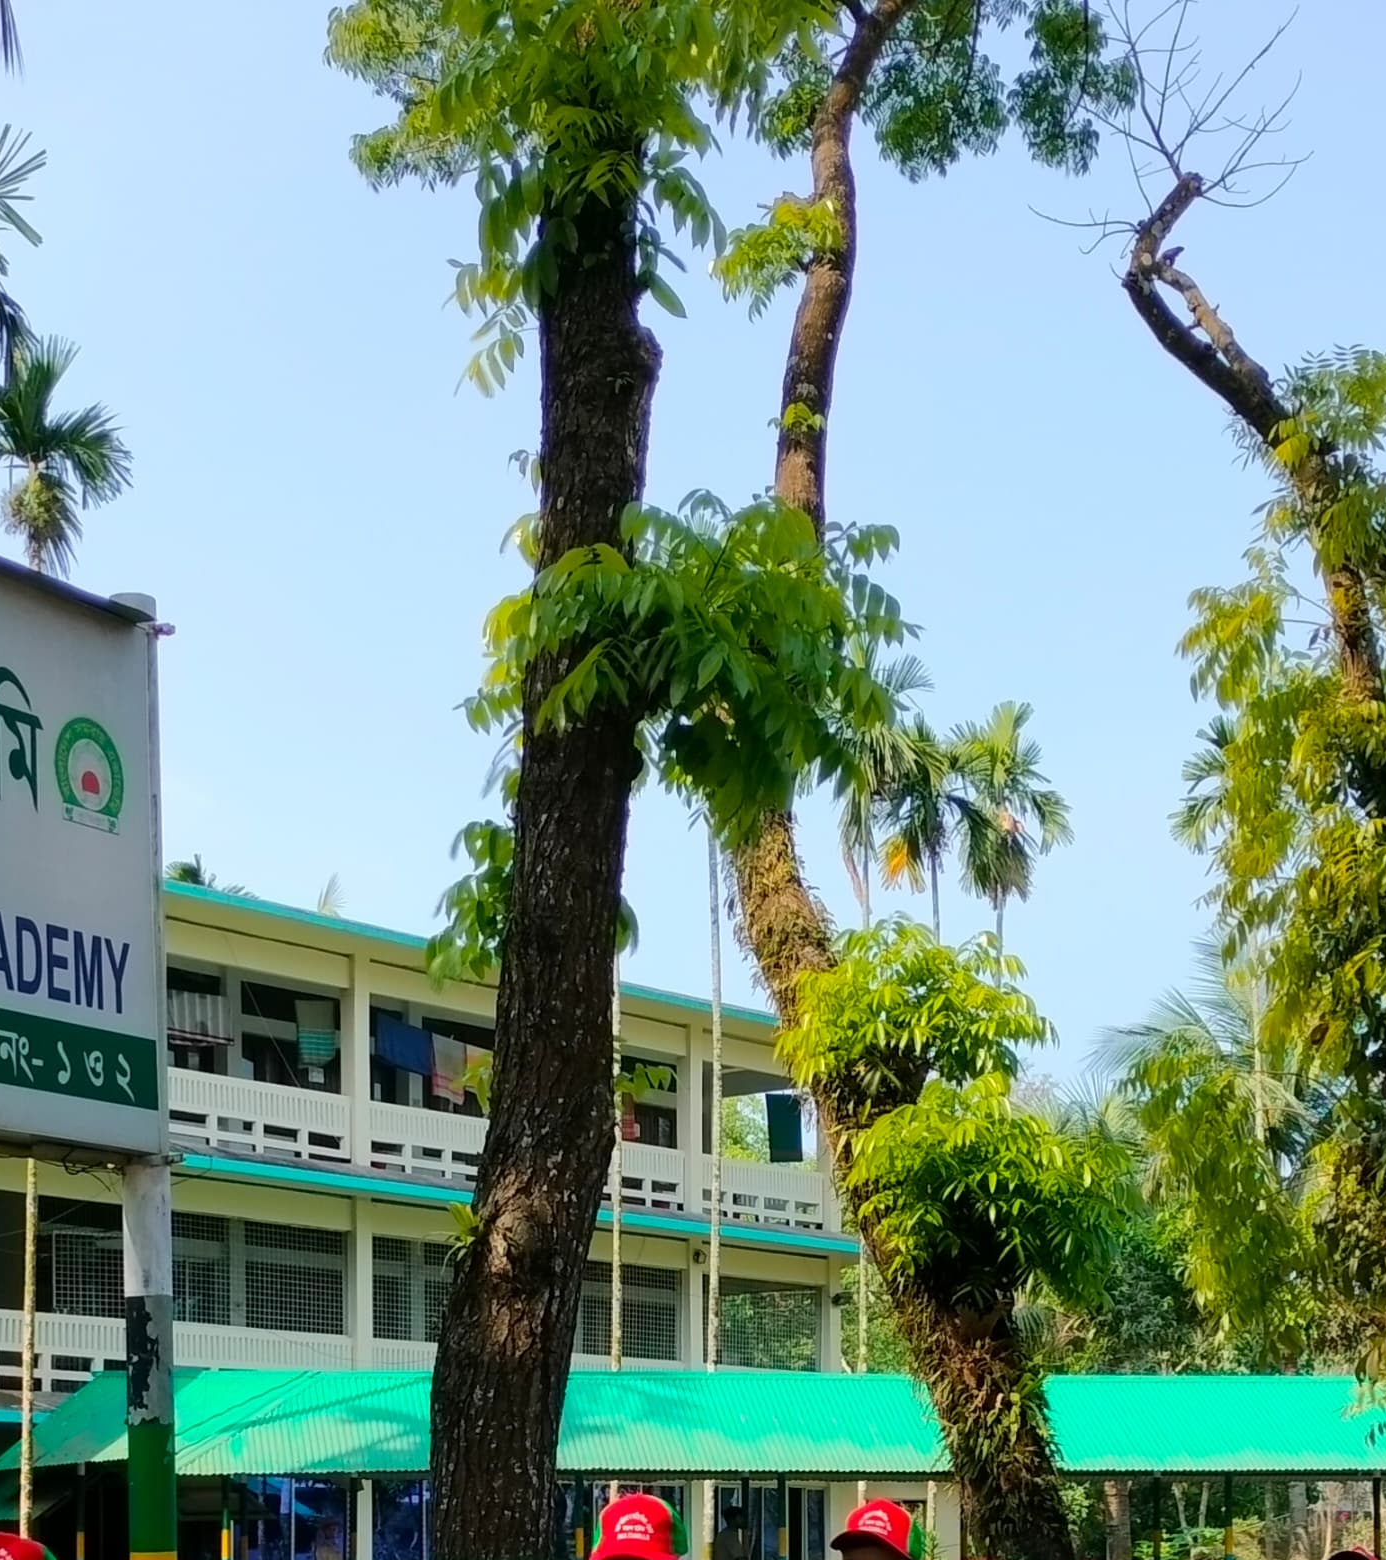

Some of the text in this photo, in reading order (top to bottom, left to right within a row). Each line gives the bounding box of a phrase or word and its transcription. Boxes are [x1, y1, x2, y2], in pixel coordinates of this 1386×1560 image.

[55, 1039, 72, 1087] ১
[83, 1051, 105, 1092] ও
[116, 1058, 135, 1103] ২
